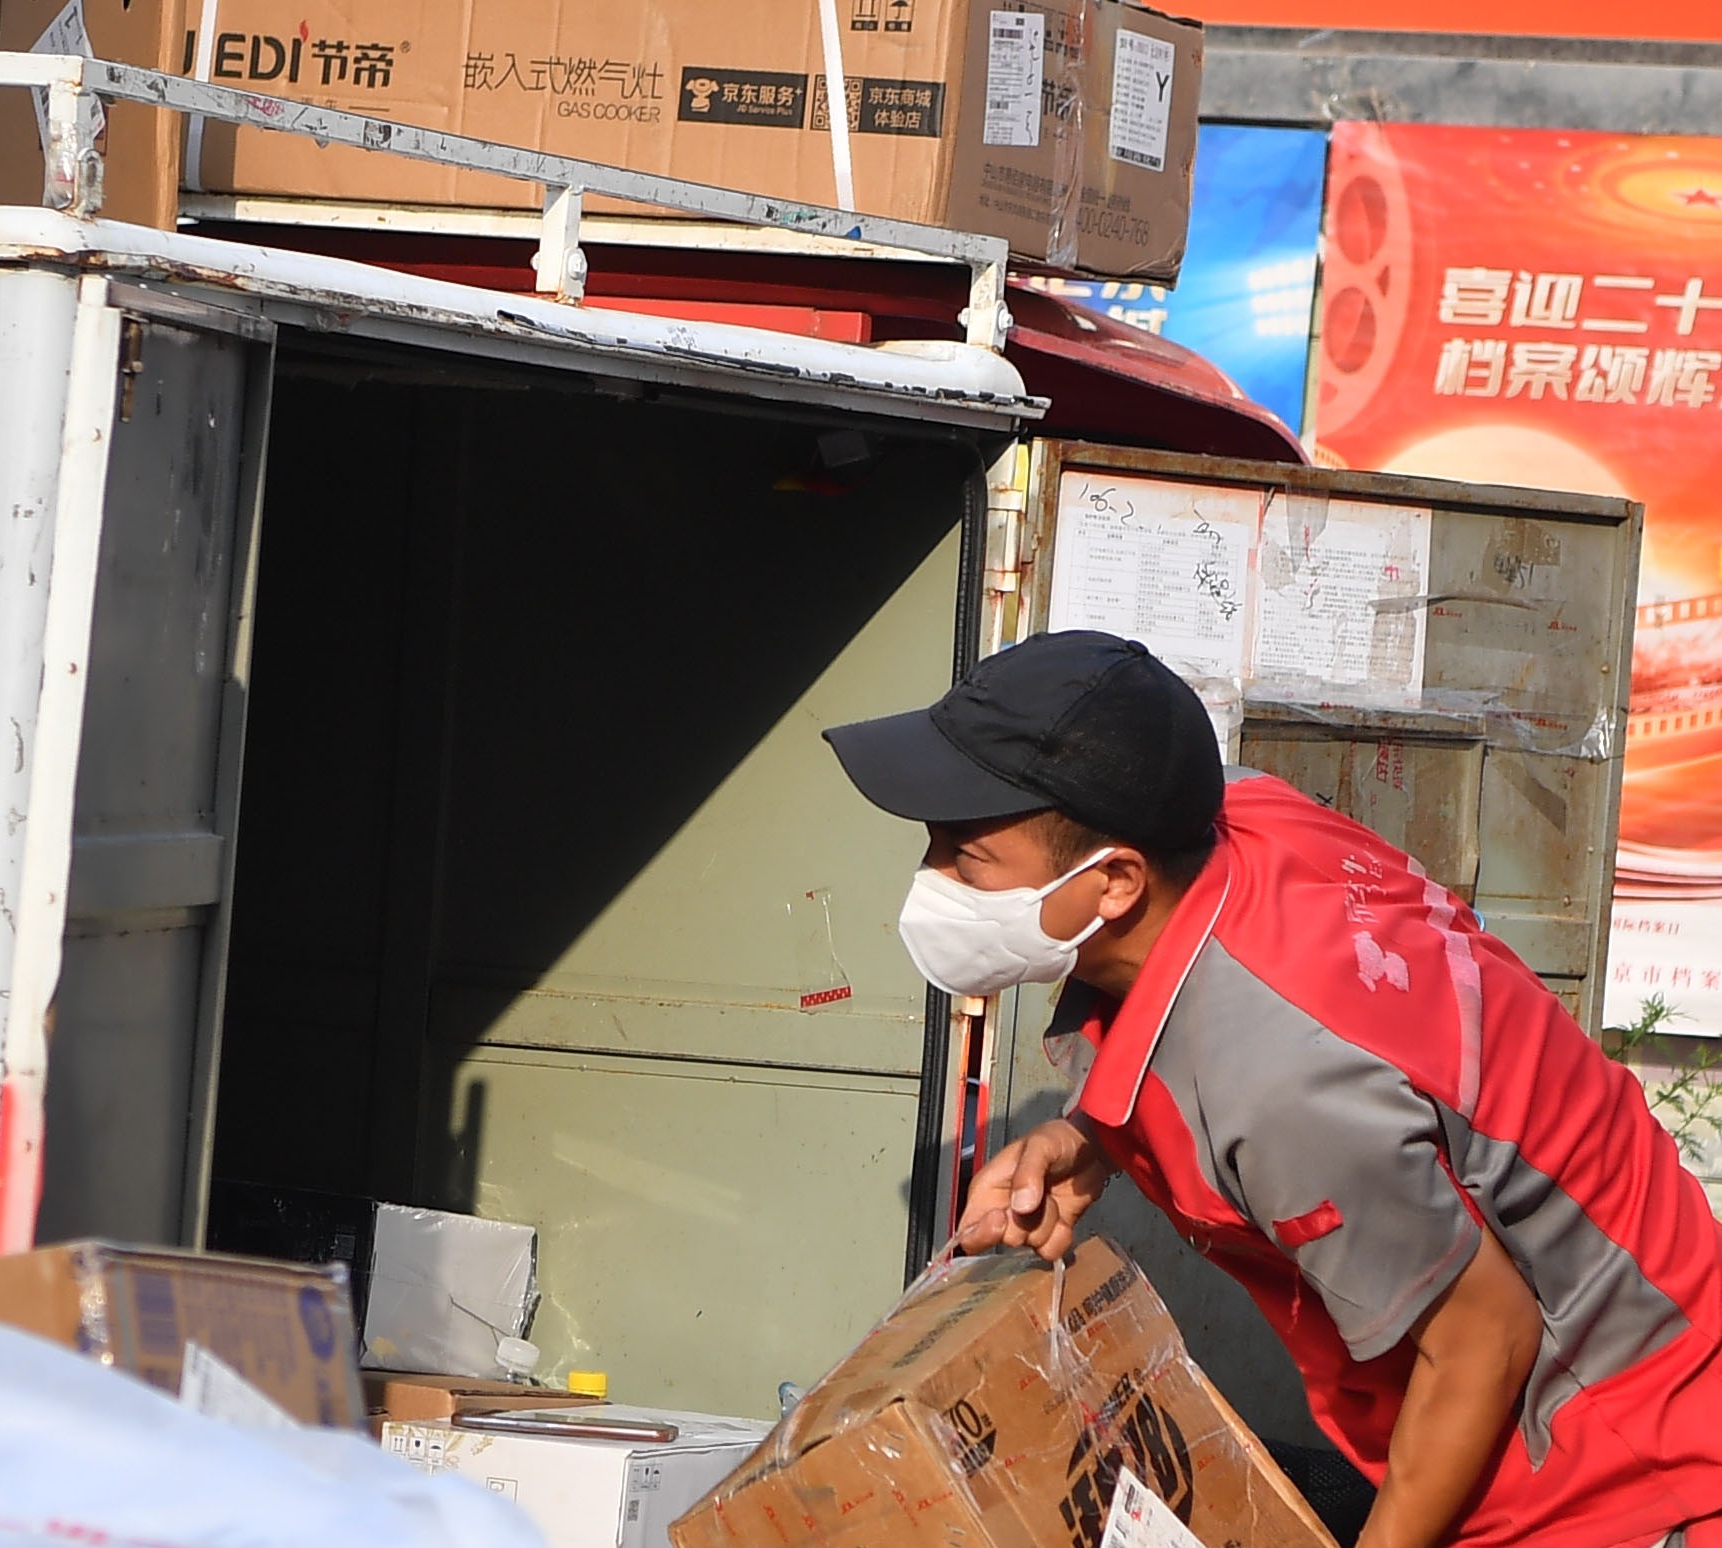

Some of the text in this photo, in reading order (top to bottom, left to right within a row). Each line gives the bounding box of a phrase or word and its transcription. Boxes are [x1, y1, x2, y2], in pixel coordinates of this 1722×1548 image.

[311, 39, 394, 89] 节帝
[462, 52, 664, 101] 嵌入式燃气灶
[868, 87, 933, 107] 京东商城
[1156, 71, 1170, 103] Y
[557, 100, 661, 123] GAS COOKER
